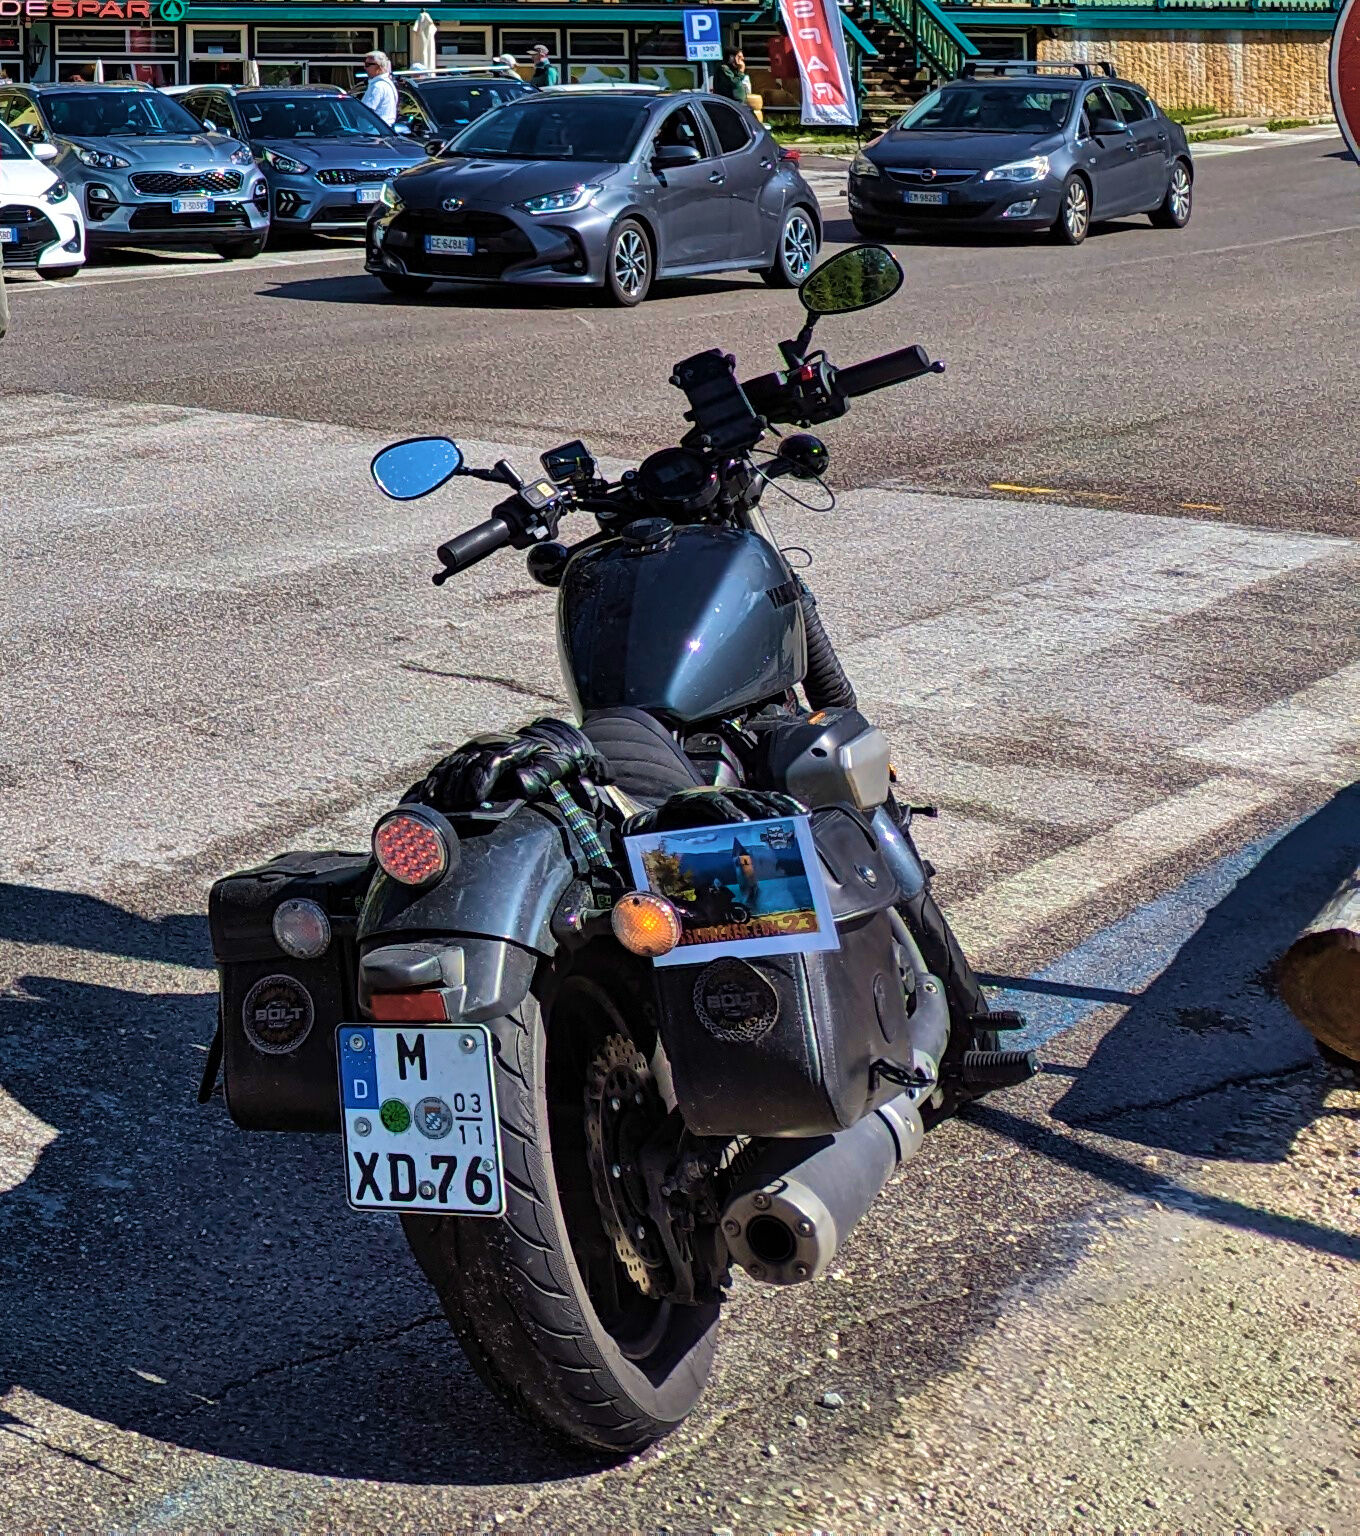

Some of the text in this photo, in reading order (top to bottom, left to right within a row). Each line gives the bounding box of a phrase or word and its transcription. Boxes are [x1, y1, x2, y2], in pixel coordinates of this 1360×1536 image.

[691, 15, 712, 40] P
[256, 1007, 303, 1021] BOLT
[396, 1033, 428, 1081] M
[353, 1079, 368, 1099] D
[453, 1093, 481, 1114] 03
[458, 1124, 483, 1146] 11
[353, 1152, 493, 1206] XD 76
